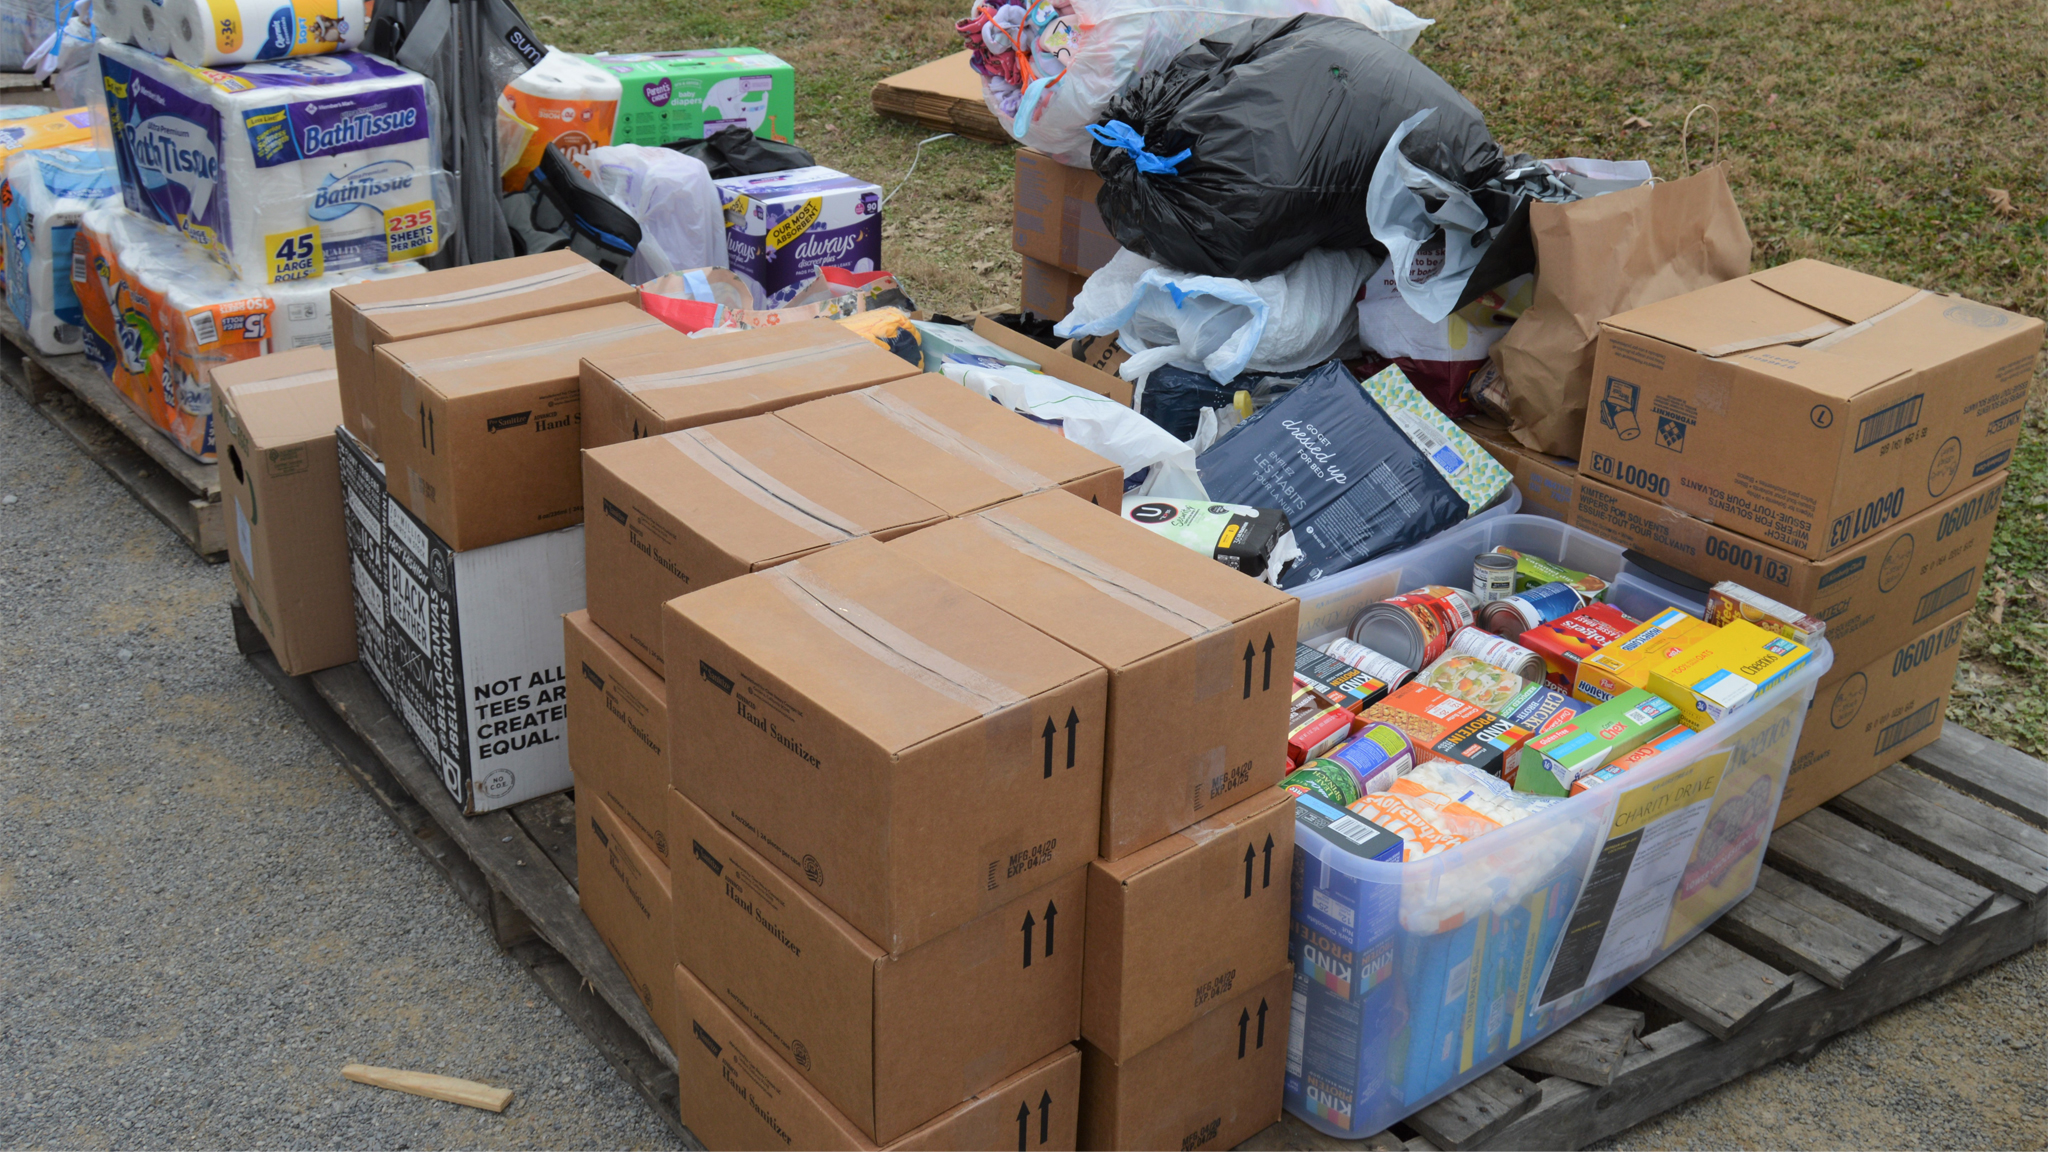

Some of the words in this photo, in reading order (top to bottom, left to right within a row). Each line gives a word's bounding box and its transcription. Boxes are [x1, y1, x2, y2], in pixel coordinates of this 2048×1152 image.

[220, 19, 233, 35] 36
[298, 17, 307, 44] SOFT
[646, 82, 671, 98] Parent's
[651, 93, 669, 104] CHOICE
[670, 96, 703, 107] diapers
[678, 91, 696, 100] baby
[160, 124, 190, 138] Premium
[388, 209, 433, 232] 235
[772, 223, 793, 239] OUR
[791, 200, 814, 226] MOST
[866, 203, 877, 211] 90
[389, 225, 434, 243] SHEETS
[775, 206, 819, 246] ABSORBENT
[275, 233, 314, 262] 45
[390, 241, 410, 253] PER
[410, 235, 433, 248] ROLL
[795, 233, 857, 260] always
[276, 258, 313, 274] LARGE
[798, 257, 823, 269] discreet
[821, 253, 836, 266] plus
[1415, 258, 1425, 266] to
[1426, 257, 1439, 266] be
[274, 270, 310, 284] ROLLS
[246, 298, 270, 310] 150
[221, 314, 244, 325] ROLLS
[223, 321, 244, 331] MEGA
[243, 312, 267, 339] 15
[498, 414, 528, 427] Sanitize
[534, 411, 558, 421] ADVANCED
[535, 414, 572, 434] Hand
[1652, 406, 1698, 427] HYDROKNIT
[1984, 413, 2021, 438] KIMTECH
[1306, 423, 1319, 436] GO
[1316, 432, 1332, 448] GET
[1268, 450, 1296, 478] ENFILEZ
[1281, 418, 1337, 464] dressed
[1326, 464, 1348, 485] up
[1297, 448, 1313, 466] FOR
[1309, 462, 1325, 479] BED
[1593, 453, 1612, 475] 03
[1253, 453, 1275, 475] LES
[1271, 470, 1308, 511] HABITS
[1616, 460, 1671, 498] 06001
[1680, 476, 1726, 500] SOLVANTS
[1252, 470, 1273, 491] POUR
[1269, 487, 1281, 502] LA
[1277, 500, 1296, 517] NUIT
[1580, 485, 1616, 505] KIMTECH
[1726, 493, 1751, 510] POUR
[1135, 506, 1163, 518] U
[1579, 494, 1609, 513] WIPERS
[1610, 505, 1627, 519] FOR
[1627, 512, 1670, 537] SOLVENTS
[1707, 496, 1754, 520] SOLVENTS
[1753, 505, 1812, 532] ESSUIE-TOUT
[1754, 514, 1774, 528] FOR
[1796, 508, 1814, 519] Wipers
[1852, 487, 1905, 539] 06001
[1936, 493, 1985, 542] 06001
[1982, 487, 2001, 516] 03
[1578, 503, 1629, 531] ESSUIE-TOUT
[1629, 522, 1652, 539] POUR
[1652, 531, 1696, 556] SOLVANTS
[1764, 530, 1808, 550] KIMTECH
[1775, 522, 1810, 541] WIPERS
[1830, 515, 1852, 547] 03
[361, 527, 382, 571] USA
[628, 529, 652, 556] Hand
[653, 549, 690, 585] Sanitizer
[1705, 535, 1764, 576] 06001
[1766, 560, 1790, 585] 03
[1525, 557, 1561, 577] caramel
[391, 561, 427, 626] BLACK
[392, 594, 429, 650] HEATHER
[1563, 620, 1613, 647] Folgers
[1573, 615, 1596, 628] ROAST
[391, 625, 435, 698] PRISM
[1695, 649, 1715, 662] OATS
[1892, 629, 1945, 678] 06001
[1943, 621, 1963, 648] 03
[428, 587, 449, 749] @BELLACANVAS
[1329, 668, 1362, 687] PROTEIN
[1740, 653, 1779, 676] Cheerios
[440, 597, 460, 760] #BELLACANVAS
[474, 675, 522, 702] NOT
[528, 665, 566, 689] ALL
[1339, 672, 1373, 692] KIND
[1600, 680, 1614, 689] Post
[396, 675, 437, 731] CALIFORNIA
[407, 678, 436, 718] ANGELES
[474, 694, 531, 721] TEES
[536, 684, 567, 706] AR
[1515, 700, 1539, 722] BROTH
[1520, 691, 1565, 731] CHICKE
[477, 703, 568, 740] CREATE
[606, 696, 627, 725] Hand
[627, 715, 662, 756] Sanitizer
[1448, 712, 1498, 743] PROTEIN
[1476, 719, 1515, 742] KIND
[1599, 720, 1628, 741] Chex
[1601, 720, 1614, 729] Corn
[1680, 714, 1701, 728] Disease
[479, 728, 560, 760] EQUAL.
[736, 701, 768, 734] Hand
[770, 722, 821, 770] Sanitizer
[1539, 734, 1556, 746] Gluten
[1555, 728, 1571, 738] Free
[1625, 747, 1654, 763] Chex
[489, 782, 509, 791] C.O.E.
[1209, 772, 1250, 800] EXP.04/25
[1210, 760, 1254, 789] MFG.04/20
[1312, 769, 1342, 802] SPINACH
[1614, 791, 1672, 828] CHARITY
[1673, 775, 1716, 803] DRIVE
[766, 838, 783, 854] pieces
[791, 855, 802, 868] case
[1007, 851, 1053, 880] EXP.04/25
[1009, 838, 1057, 867] MFG.04/20
[609, 853, 626, 884] Hand
[624, 880, 651, 921] Sanitizer
[725, 882, 753, 916] Hand
[755, 908, 802, 958] Sanitizer
[1306, 913, 1337, 939] Chocolate
[1303, 943, 1352, 984] KIND
[1360, 948, 1394, 980] KIND
[1193, 981, 1233, 1008] EXP.04/25
[1195, 968, 1237, 997] MFG.04/20
[1306, 1084, 1352, 1118] KIND
[1307, 1073, 1353, 1103] PROTEIN
[722, 1065, 747, 1105] Hand
[748, 1096, 793, 1147] Sanitizer
